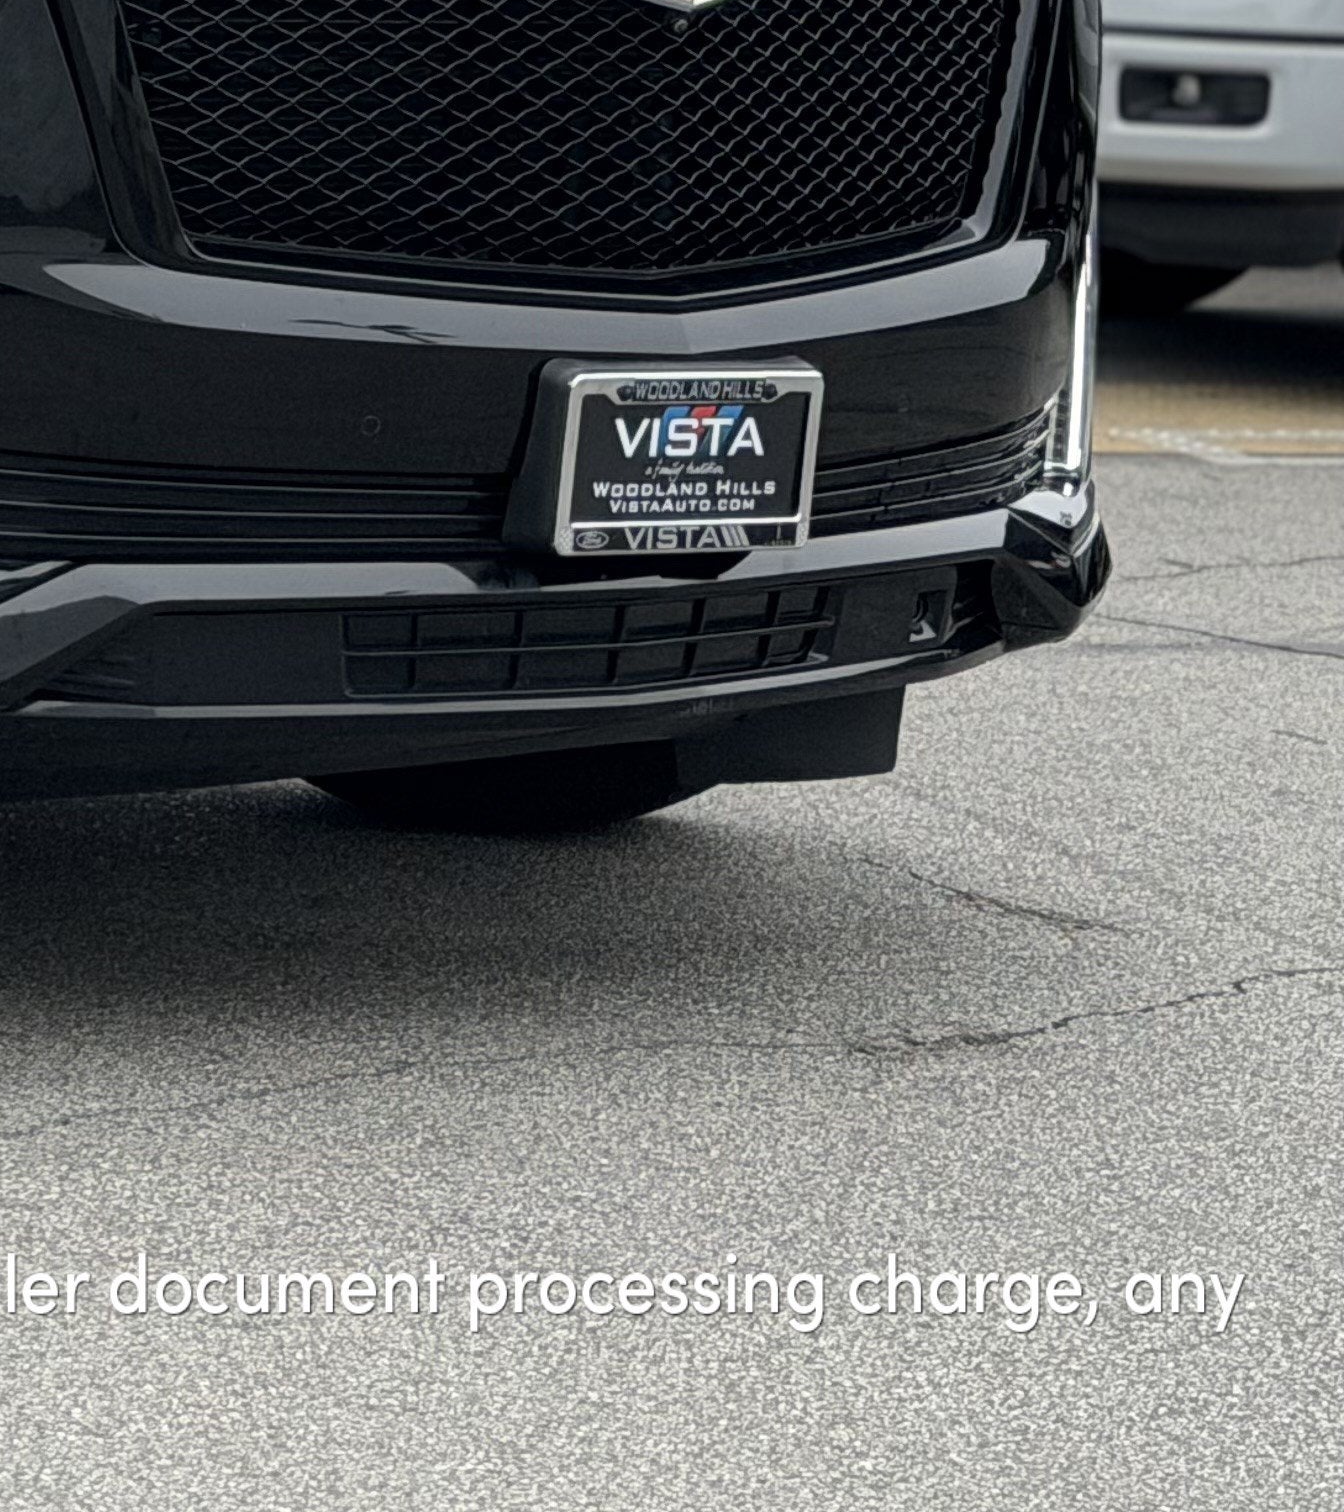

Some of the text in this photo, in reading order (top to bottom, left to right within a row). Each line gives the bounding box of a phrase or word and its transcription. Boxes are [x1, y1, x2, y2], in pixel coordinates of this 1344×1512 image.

[634, 379, 764, 402] WOODLAND HILLS
[614, 416, 765, 459] VISTA
[592, 479, 777, 499] WOODLAND HILLS
[624, 525, 722, 550] VISTA
